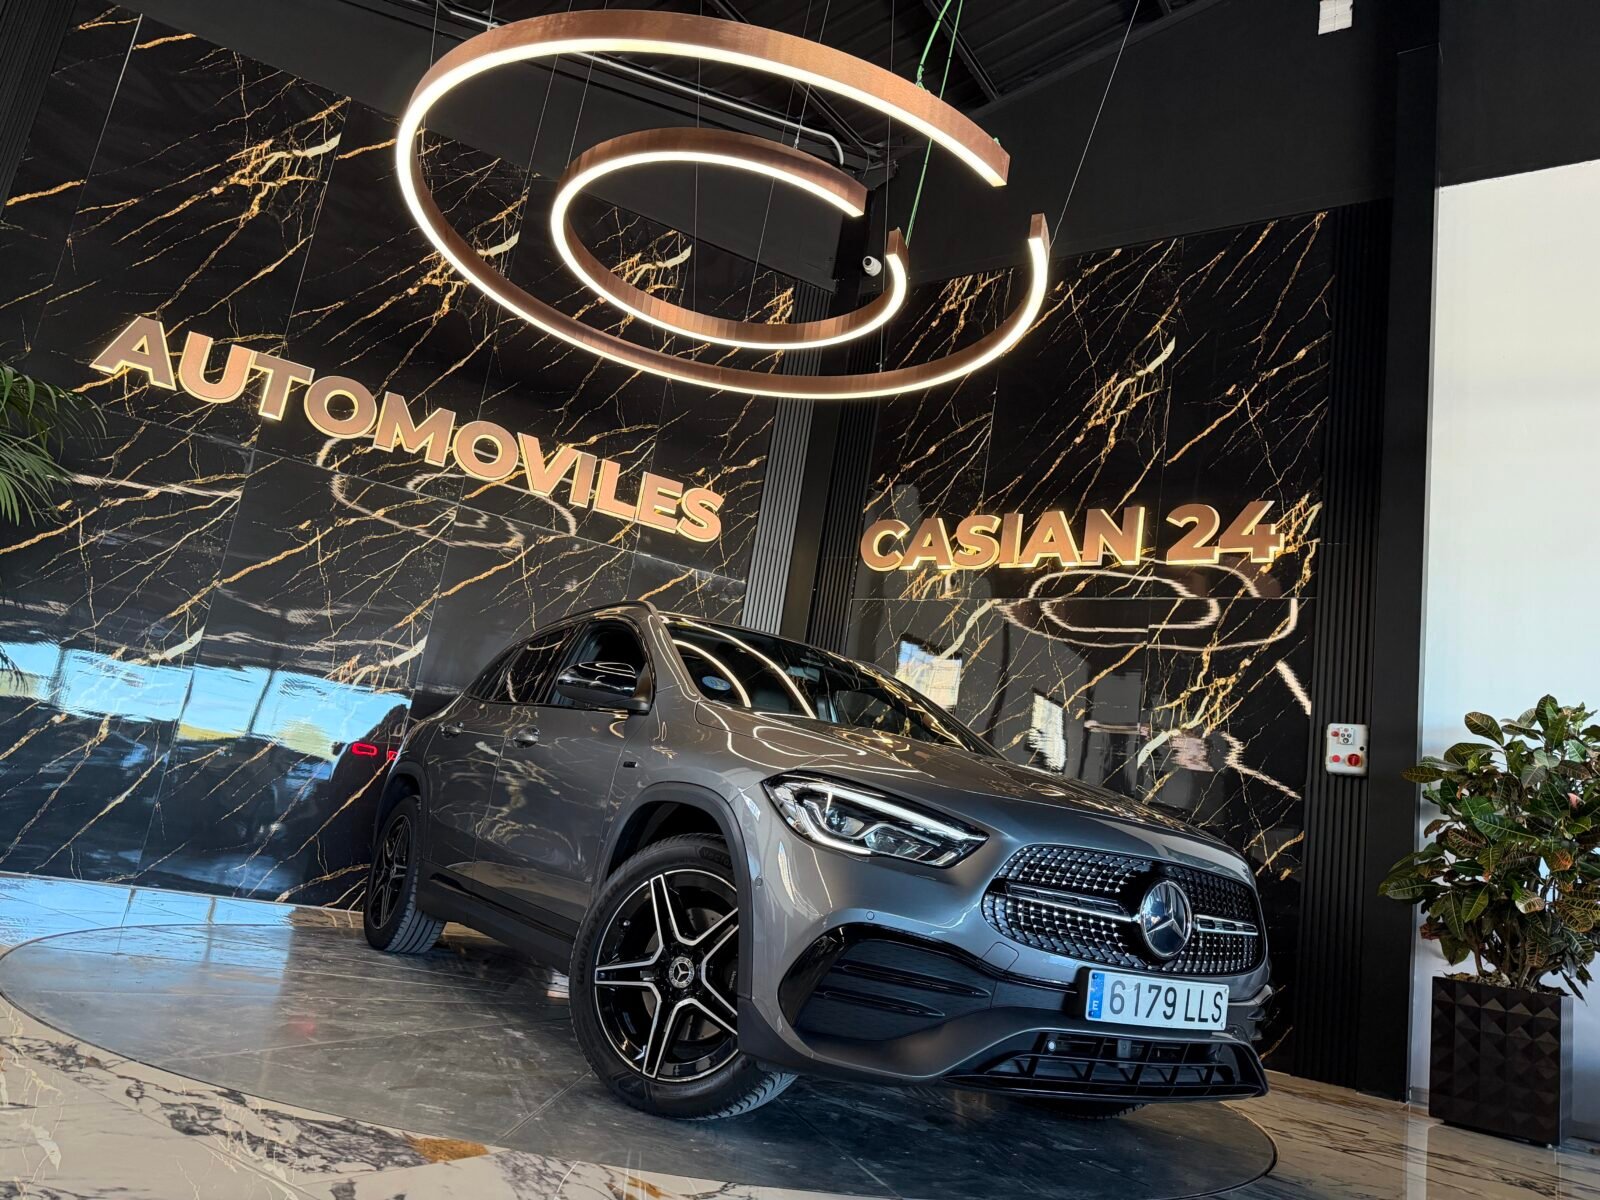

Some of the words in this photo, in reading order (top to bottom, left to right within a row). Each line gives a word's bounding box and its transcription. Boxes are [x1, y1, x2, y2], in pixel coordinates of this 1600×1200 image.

[89, 315, 725, 543] AUTOMOVILES
[860, 506, 1146, 571] CASIAN
[1166, 500, 1286, 564] 24
[1092, 1000, 1099, 1011] E
[1109, 980, 1178, 1021] 6179
[1184, 988, 1224, 1023] LLS
